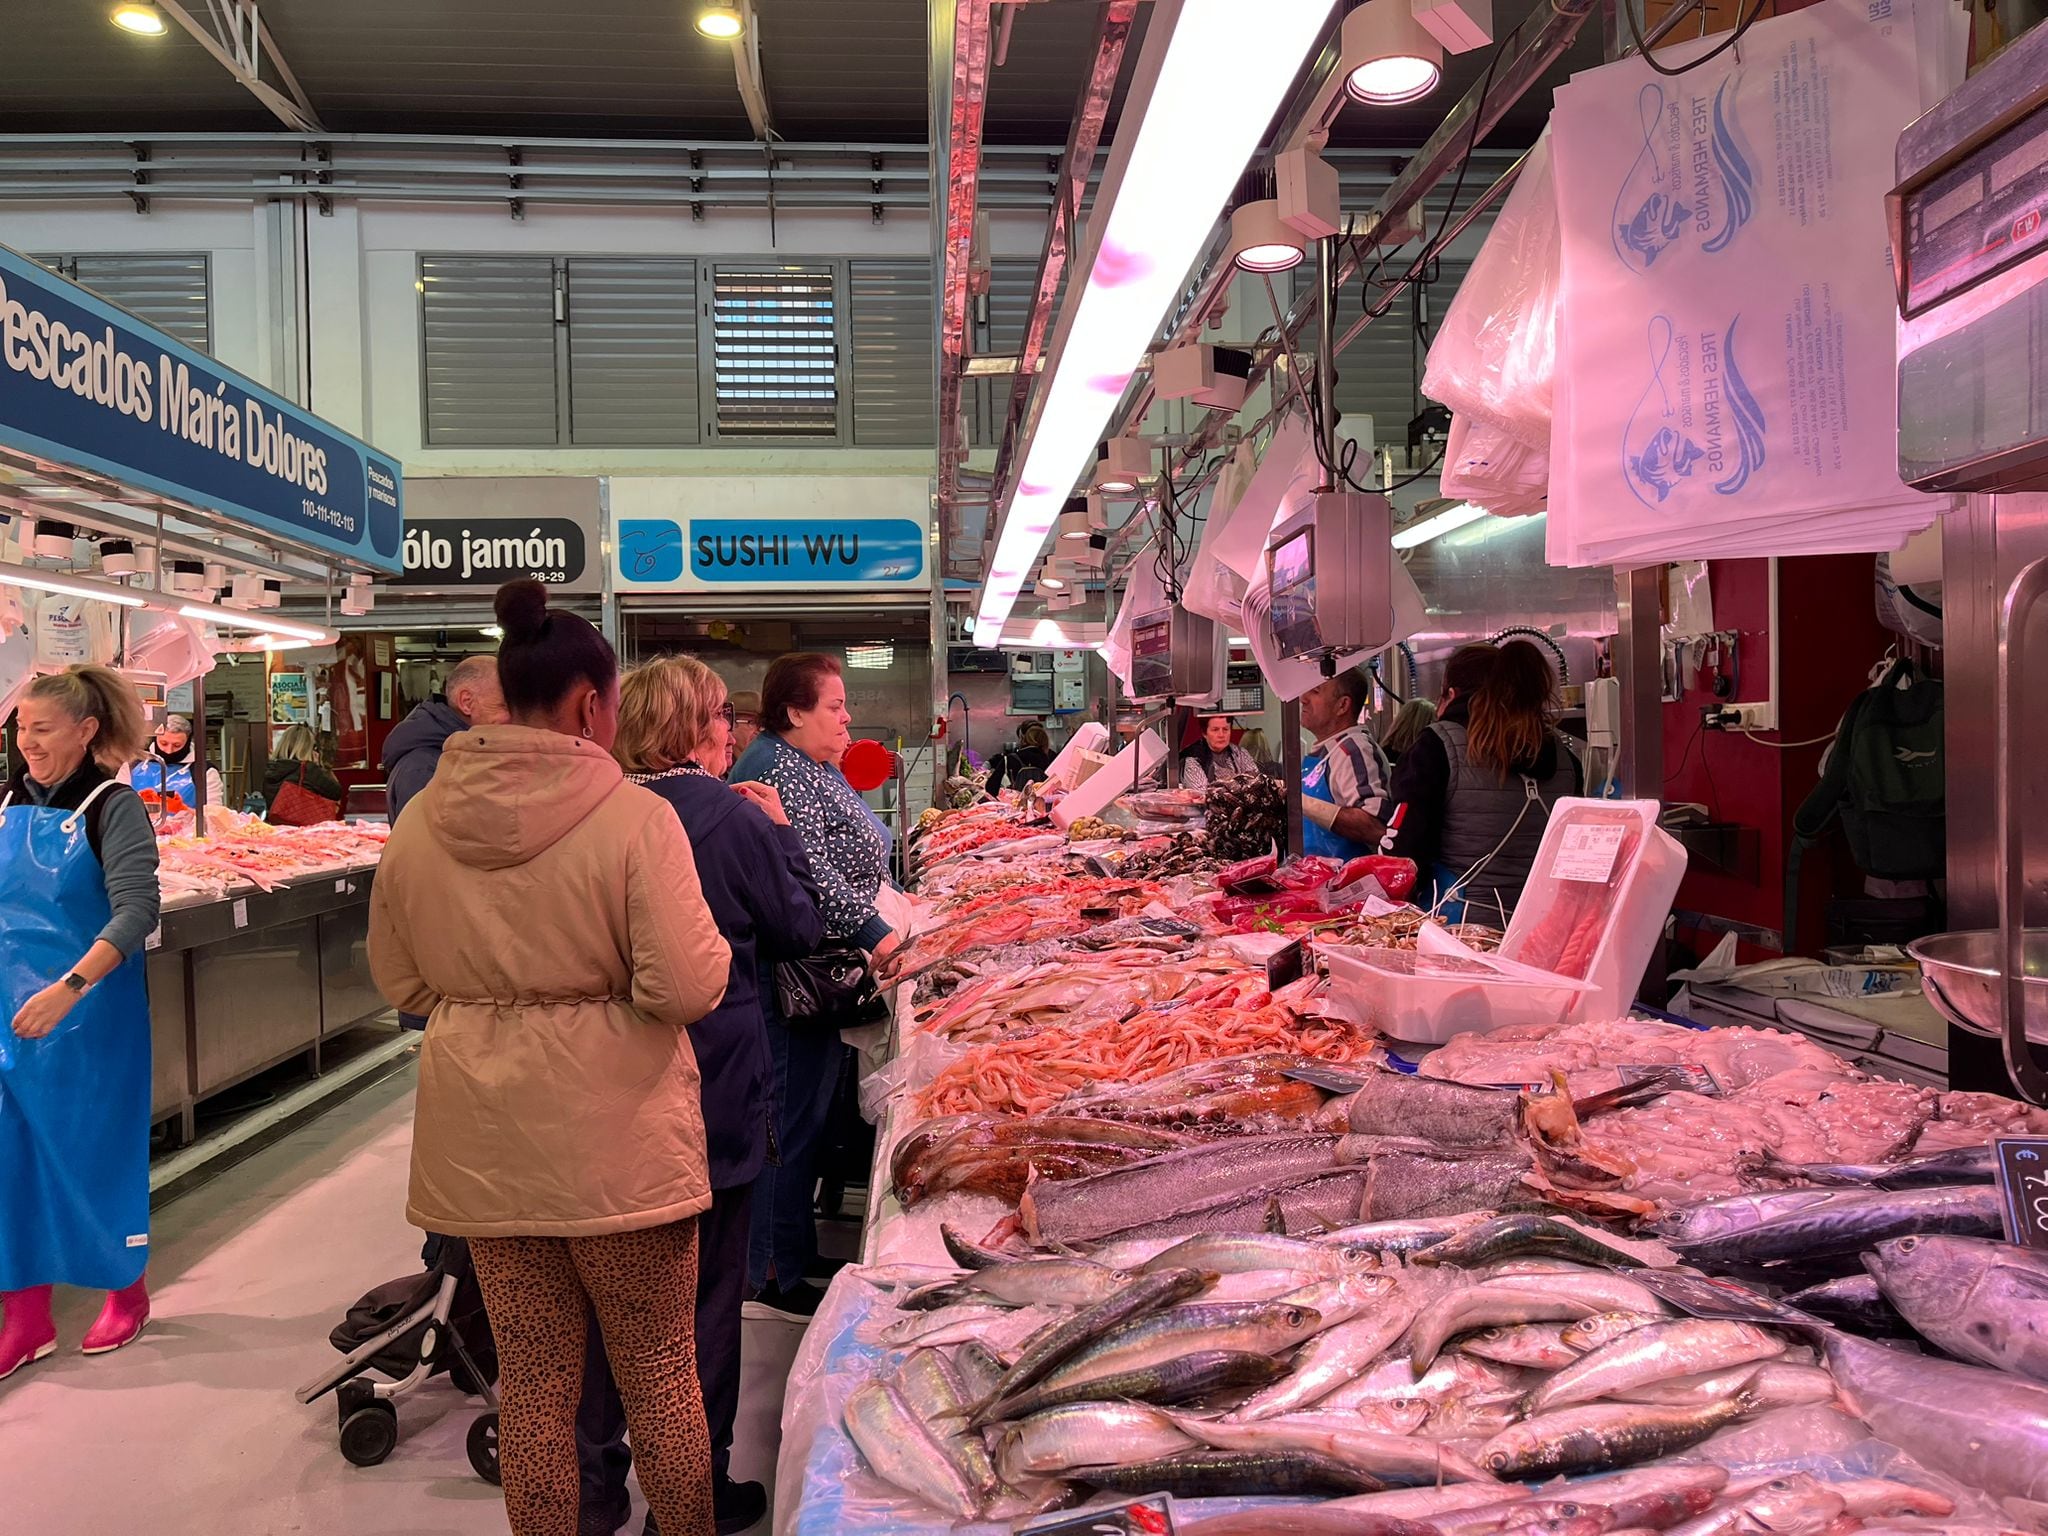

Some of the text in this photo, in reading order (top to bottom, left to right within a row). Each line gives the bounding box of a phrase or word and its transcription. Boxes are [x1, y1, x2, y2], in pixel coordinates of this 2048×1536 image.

[160, 354, 241, 461] María
[246, 398, 328, 496] Dolores
[368, 466, 394, 490] Pescados
[368, 486, 396, 507] y mariscos
[302, 499, 355, 533] 110-111-112-113
[402, 528, 566, 578] ólo jamón
[698, 534, 859, 567] SUSHI WU
[530, 572, 566, 583] 28-29
[884, 566, 901, 577] 27
